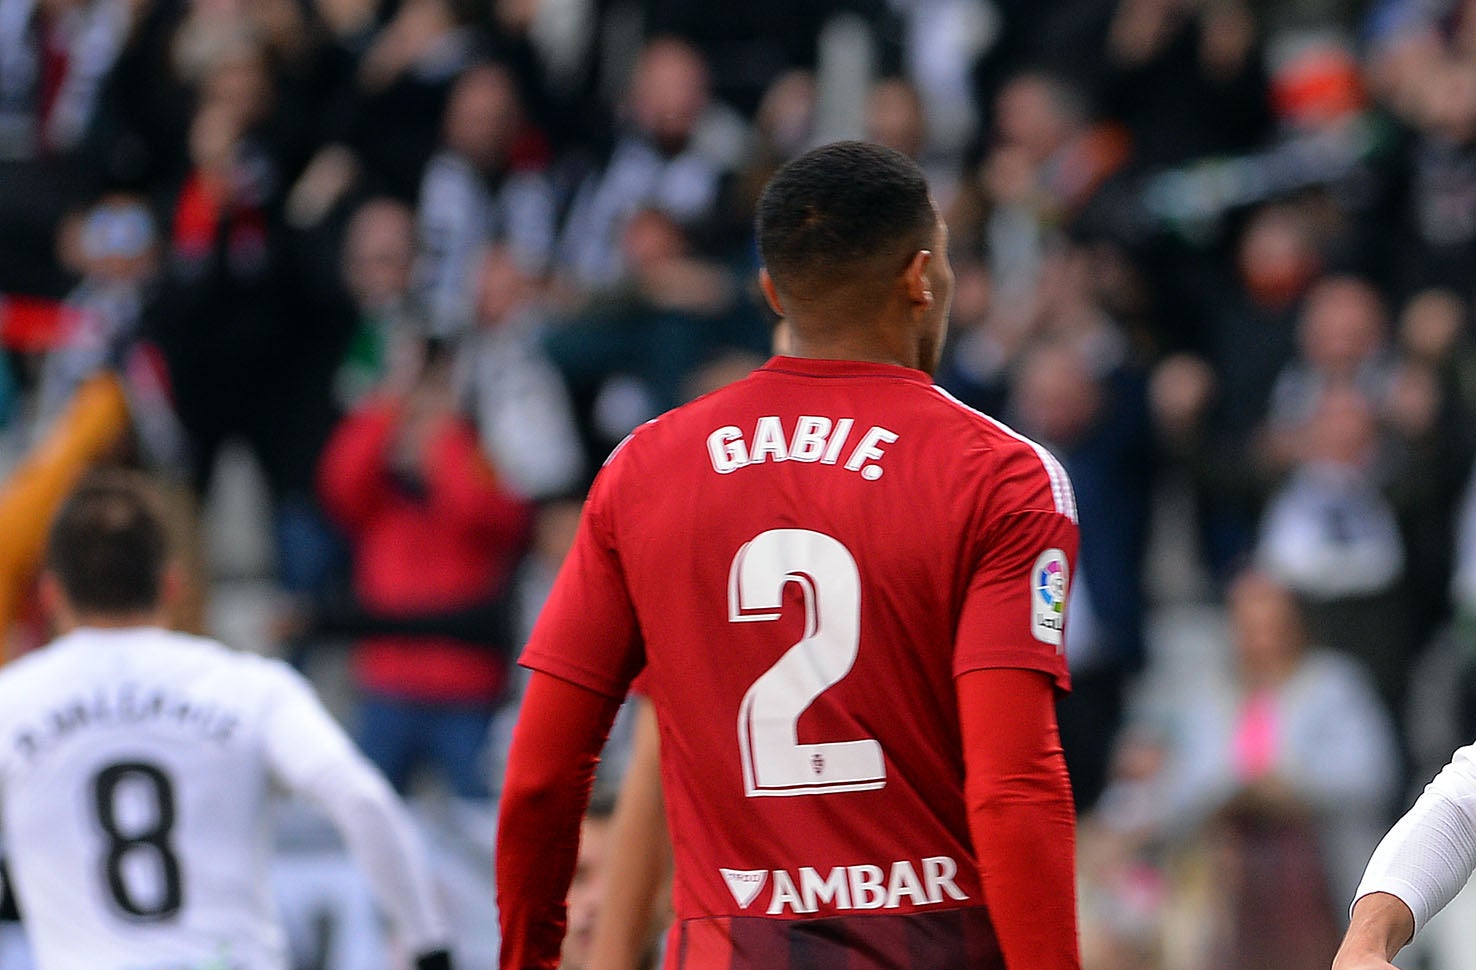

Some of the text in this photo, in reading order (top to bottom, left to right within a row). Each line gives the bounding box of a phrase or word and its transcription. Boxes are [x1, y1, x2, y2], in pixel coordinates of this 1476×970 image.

[706, 416, 900, 481] GABI F.
[728, 528, 887, 797] 2
[90, 758, 186, 926] 8
[765, 856, 970, 915] AMBAR
